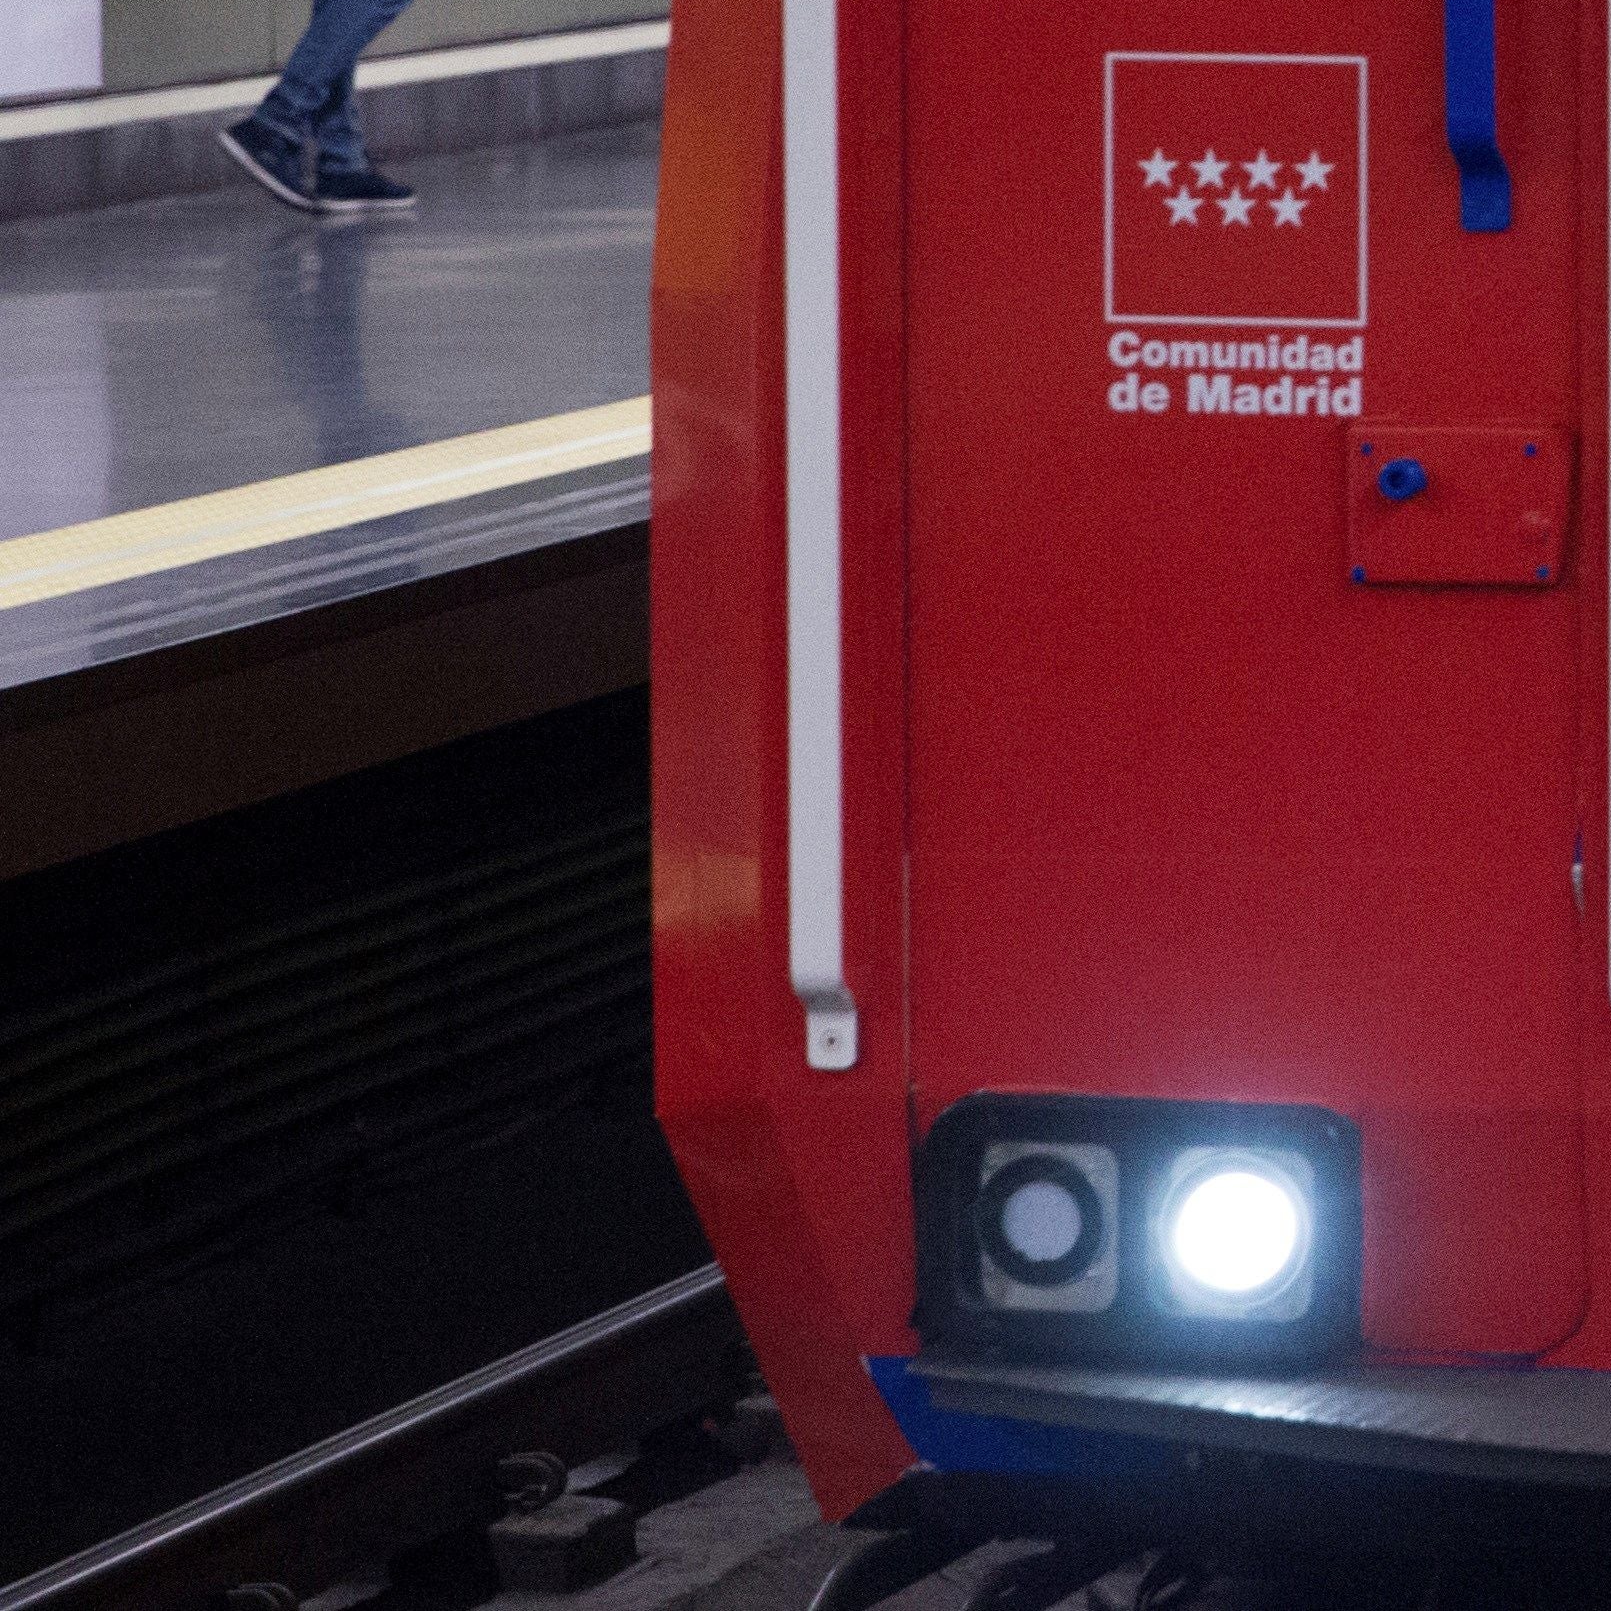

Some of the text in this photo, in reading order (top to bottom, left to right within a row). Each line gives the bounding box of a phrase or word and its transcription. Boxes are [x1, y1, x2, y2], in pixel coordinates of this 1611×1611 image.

[1108, 329, 1364, 372] Comunidad
[1108, 373, 1363, 417] de Madrid
